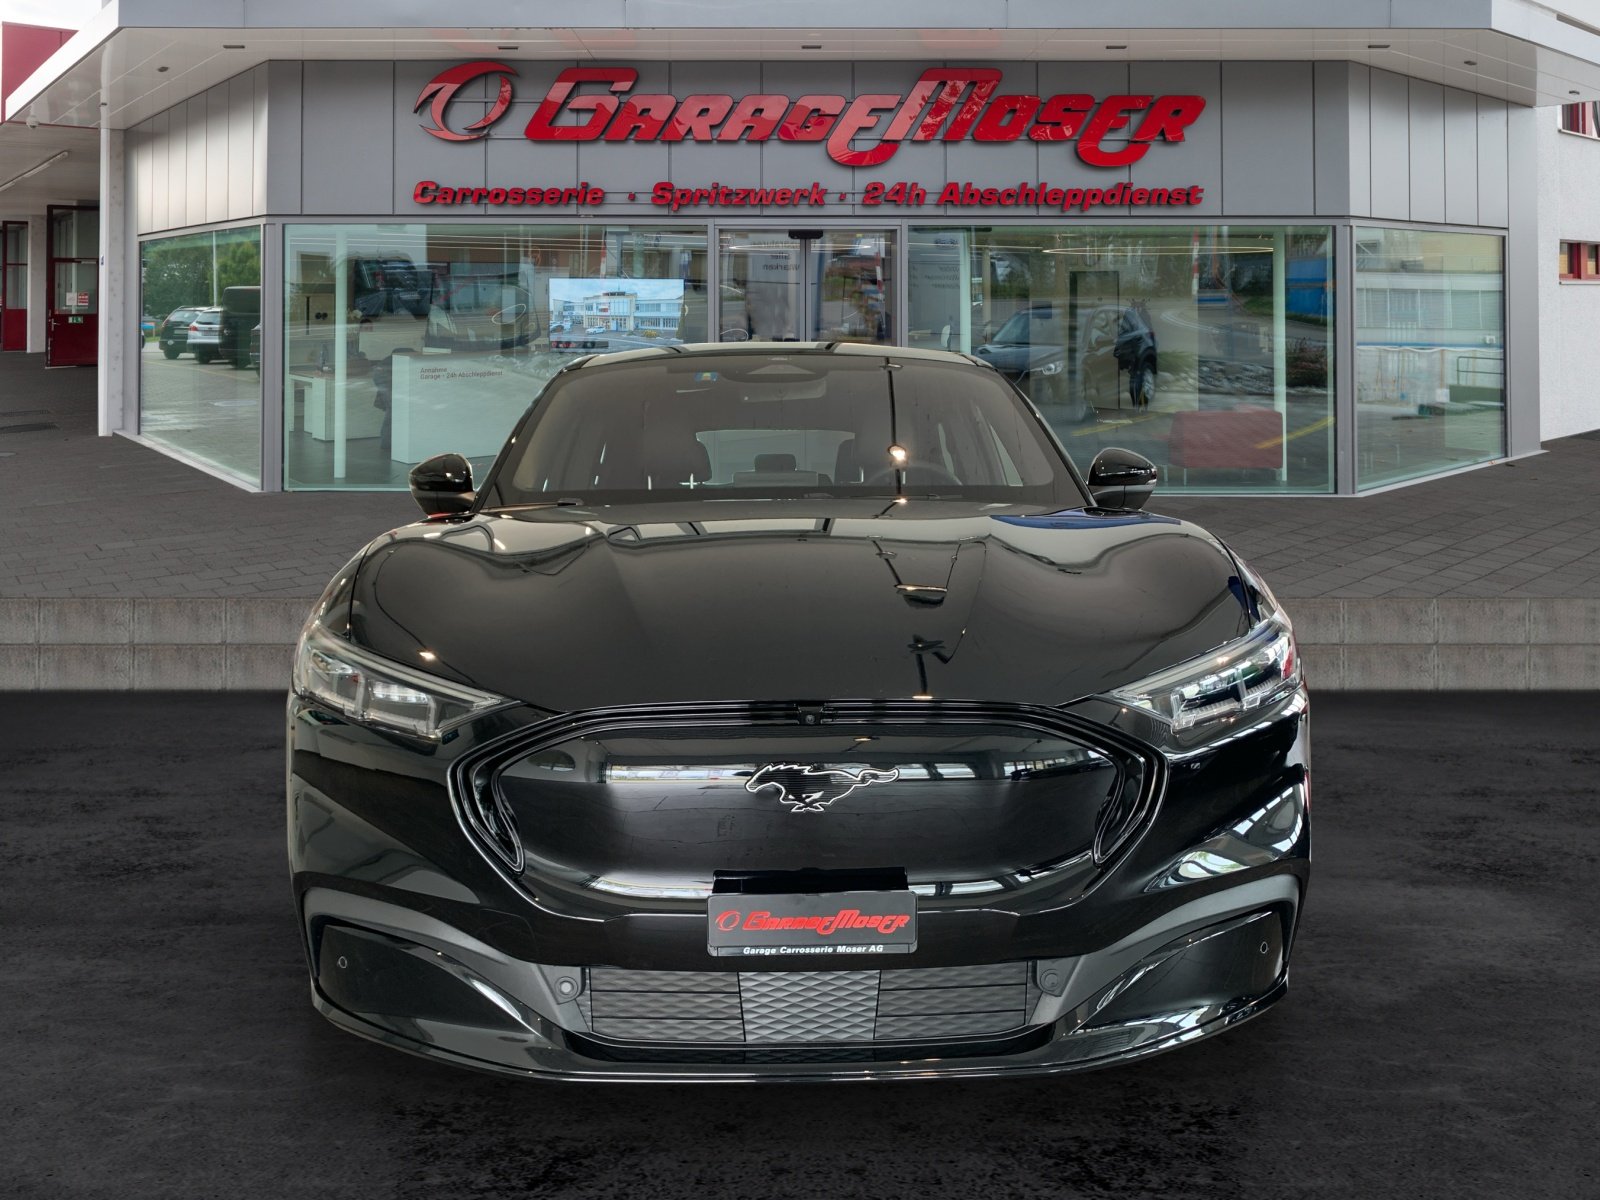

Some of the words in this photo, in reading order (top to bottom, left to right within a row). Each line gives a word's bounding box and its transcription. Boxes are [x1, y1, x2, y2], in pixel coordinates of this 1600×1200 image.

[413, 180, 604, 207] Carrosserie
[651, 181, 827, 211] Spritzwerk
[862, 181, 926, 206] 24h
[936, 181, 1204, 211] Abschleppdienst
[743, 947, 776, 955] Garage
[780, 946, 833, 954] Carrosserie
[837, 945, 867, 953] Moser
[869, 944, 884, 953] AG
